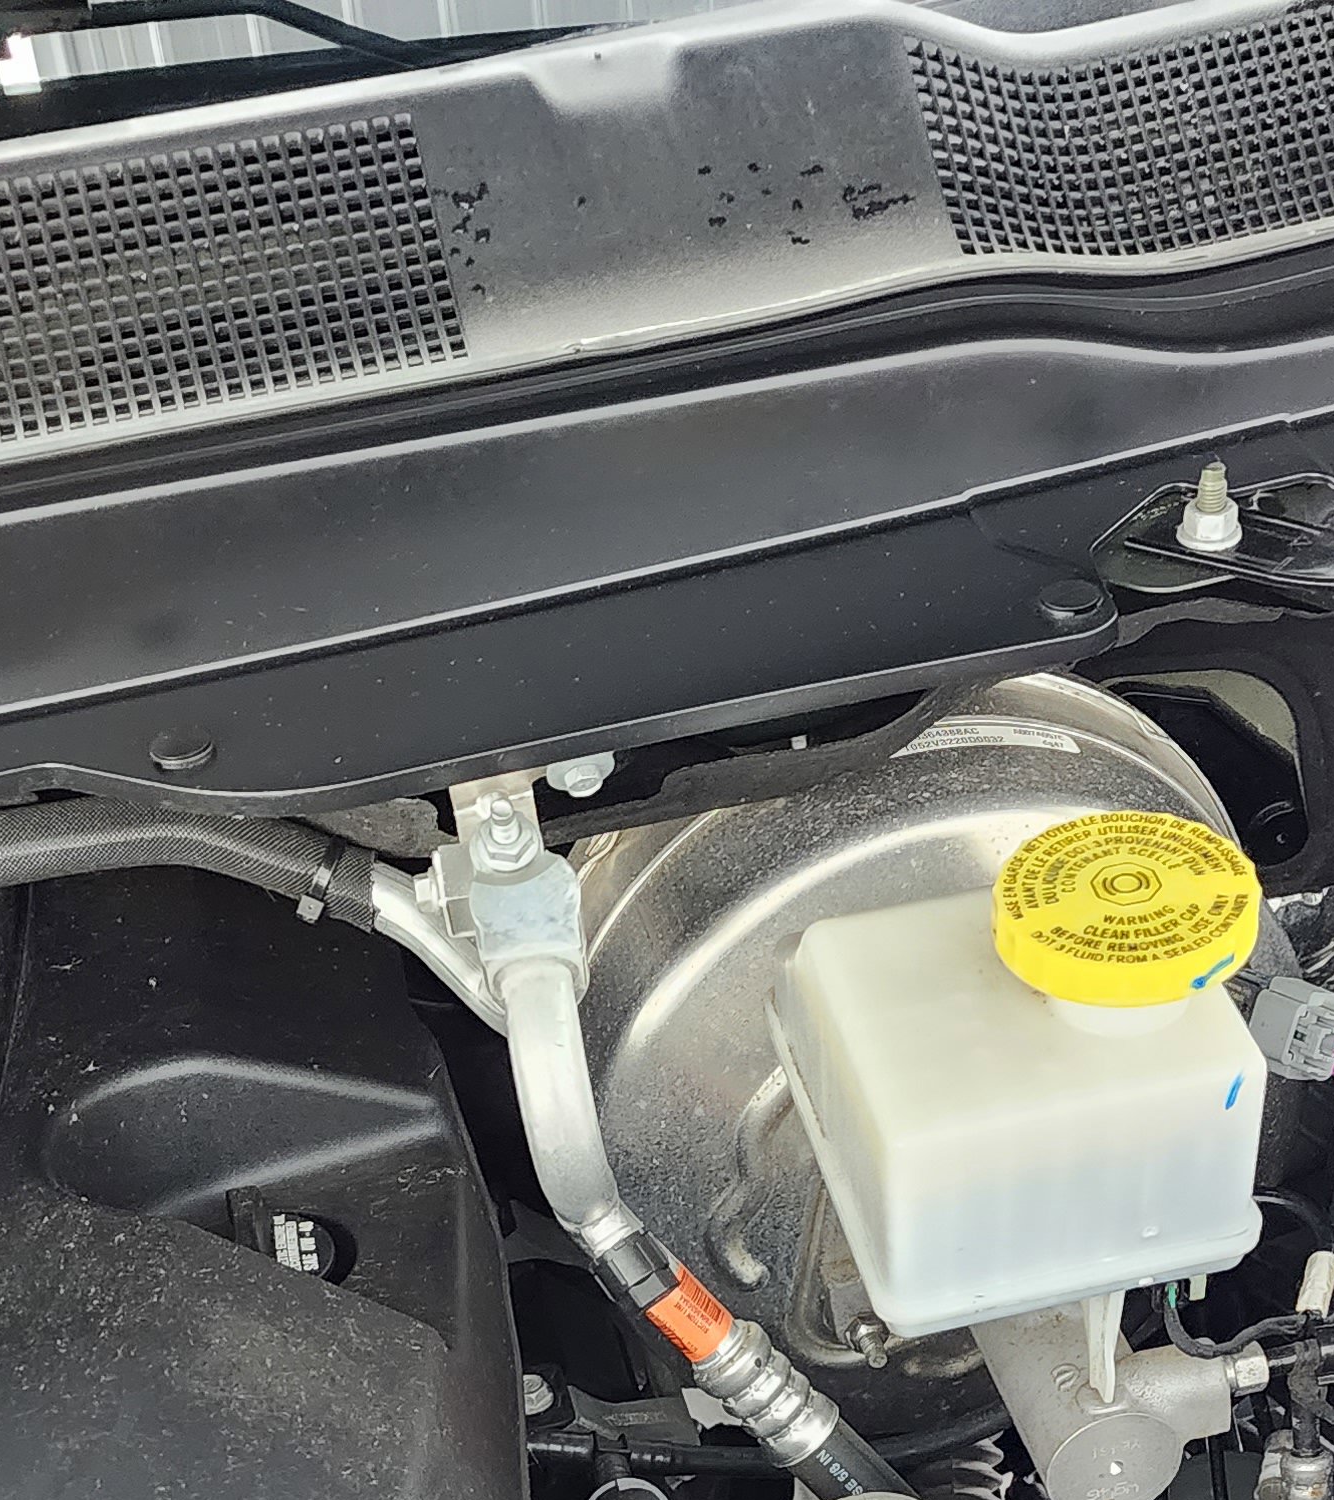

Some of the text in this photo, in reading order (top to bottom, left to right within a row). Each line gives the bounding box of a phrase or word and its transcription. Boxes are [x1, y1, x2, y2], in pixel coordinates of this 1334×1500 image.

[1003, 886, 1018, 898] EN
[1080, 815, 1099, 827] LE
[1100, 813, 1168, 826] BOUCHON
[1169, 819, 1189, 831] DE
[1188, 826, 1248, 877] REMPLISSAGE
[1021, 824, 1227, 909] AVANT DE LE RETIRER UTILISER UNIQUEMENT
[1061, 846, 1121, 893] CONTENANT
[1103, 835, 1189, 857] PROVENANT
[1030, 930, 1056, 946] DOT
[1065, 947, 1105, 962] FLUID
[1107, 954, 1149, 964] FROM
[1152, 953, 1161, 961] A
[1163, 935, 1213, 959] SEALED
[1209, 893, 1249, 938] CONTAINER
[1050, 925, 1103, 950] BEFORE
[1188, 916, 1214, 934] USE
[1207, 893, 1229, 917] ONLY
[1083, 902, 1201, 940] CLEAN FILLER CAP
[1103, 904, 1175, 926] WARNING
[816, 1449, 834, 1466] IN
